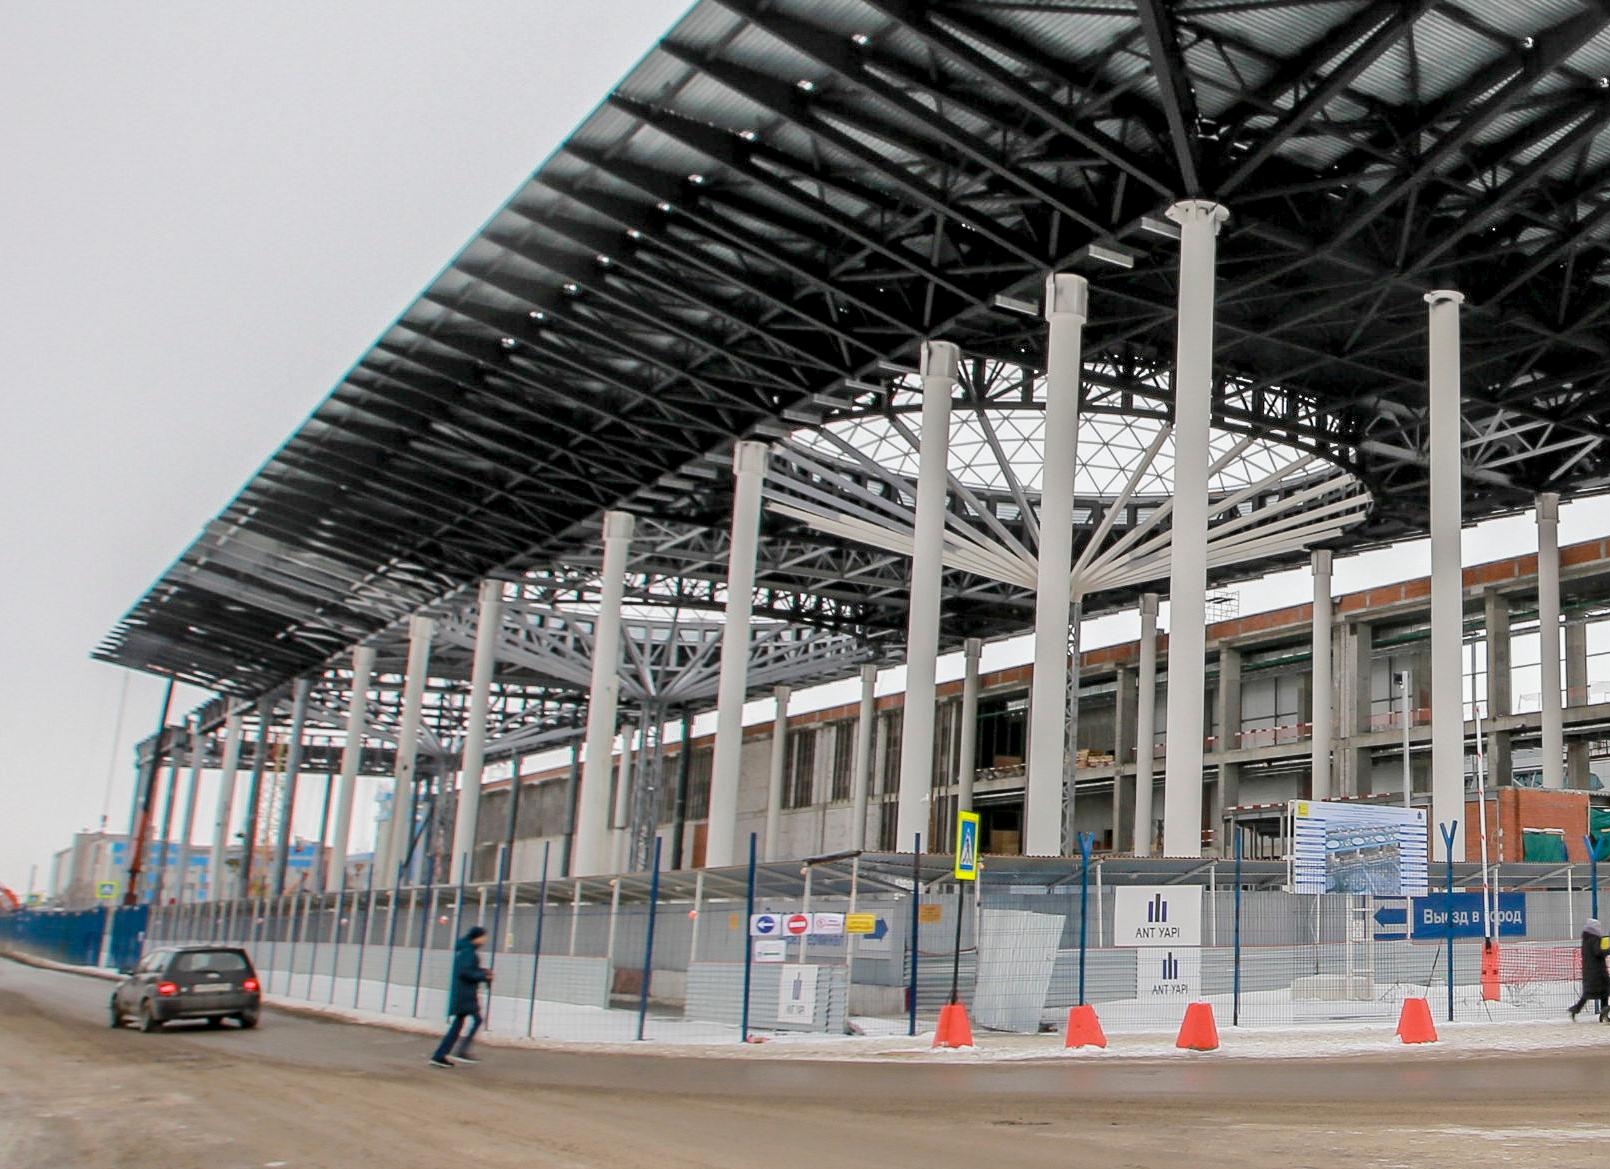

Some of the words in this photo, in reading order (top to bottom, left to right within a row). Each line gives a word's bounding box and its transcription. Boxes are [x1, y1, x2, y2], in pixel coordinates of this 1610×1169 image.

[1472, 910, 1480, 923] в
[1484, 910, 1523, 925] ород
[1135, 927, 1156, 938] ANT
[1158, 927, 1180, 938] YAPI
[1152, 984, 1170, 995] ANT
[1171, 983, 1189, 994] YAPI
